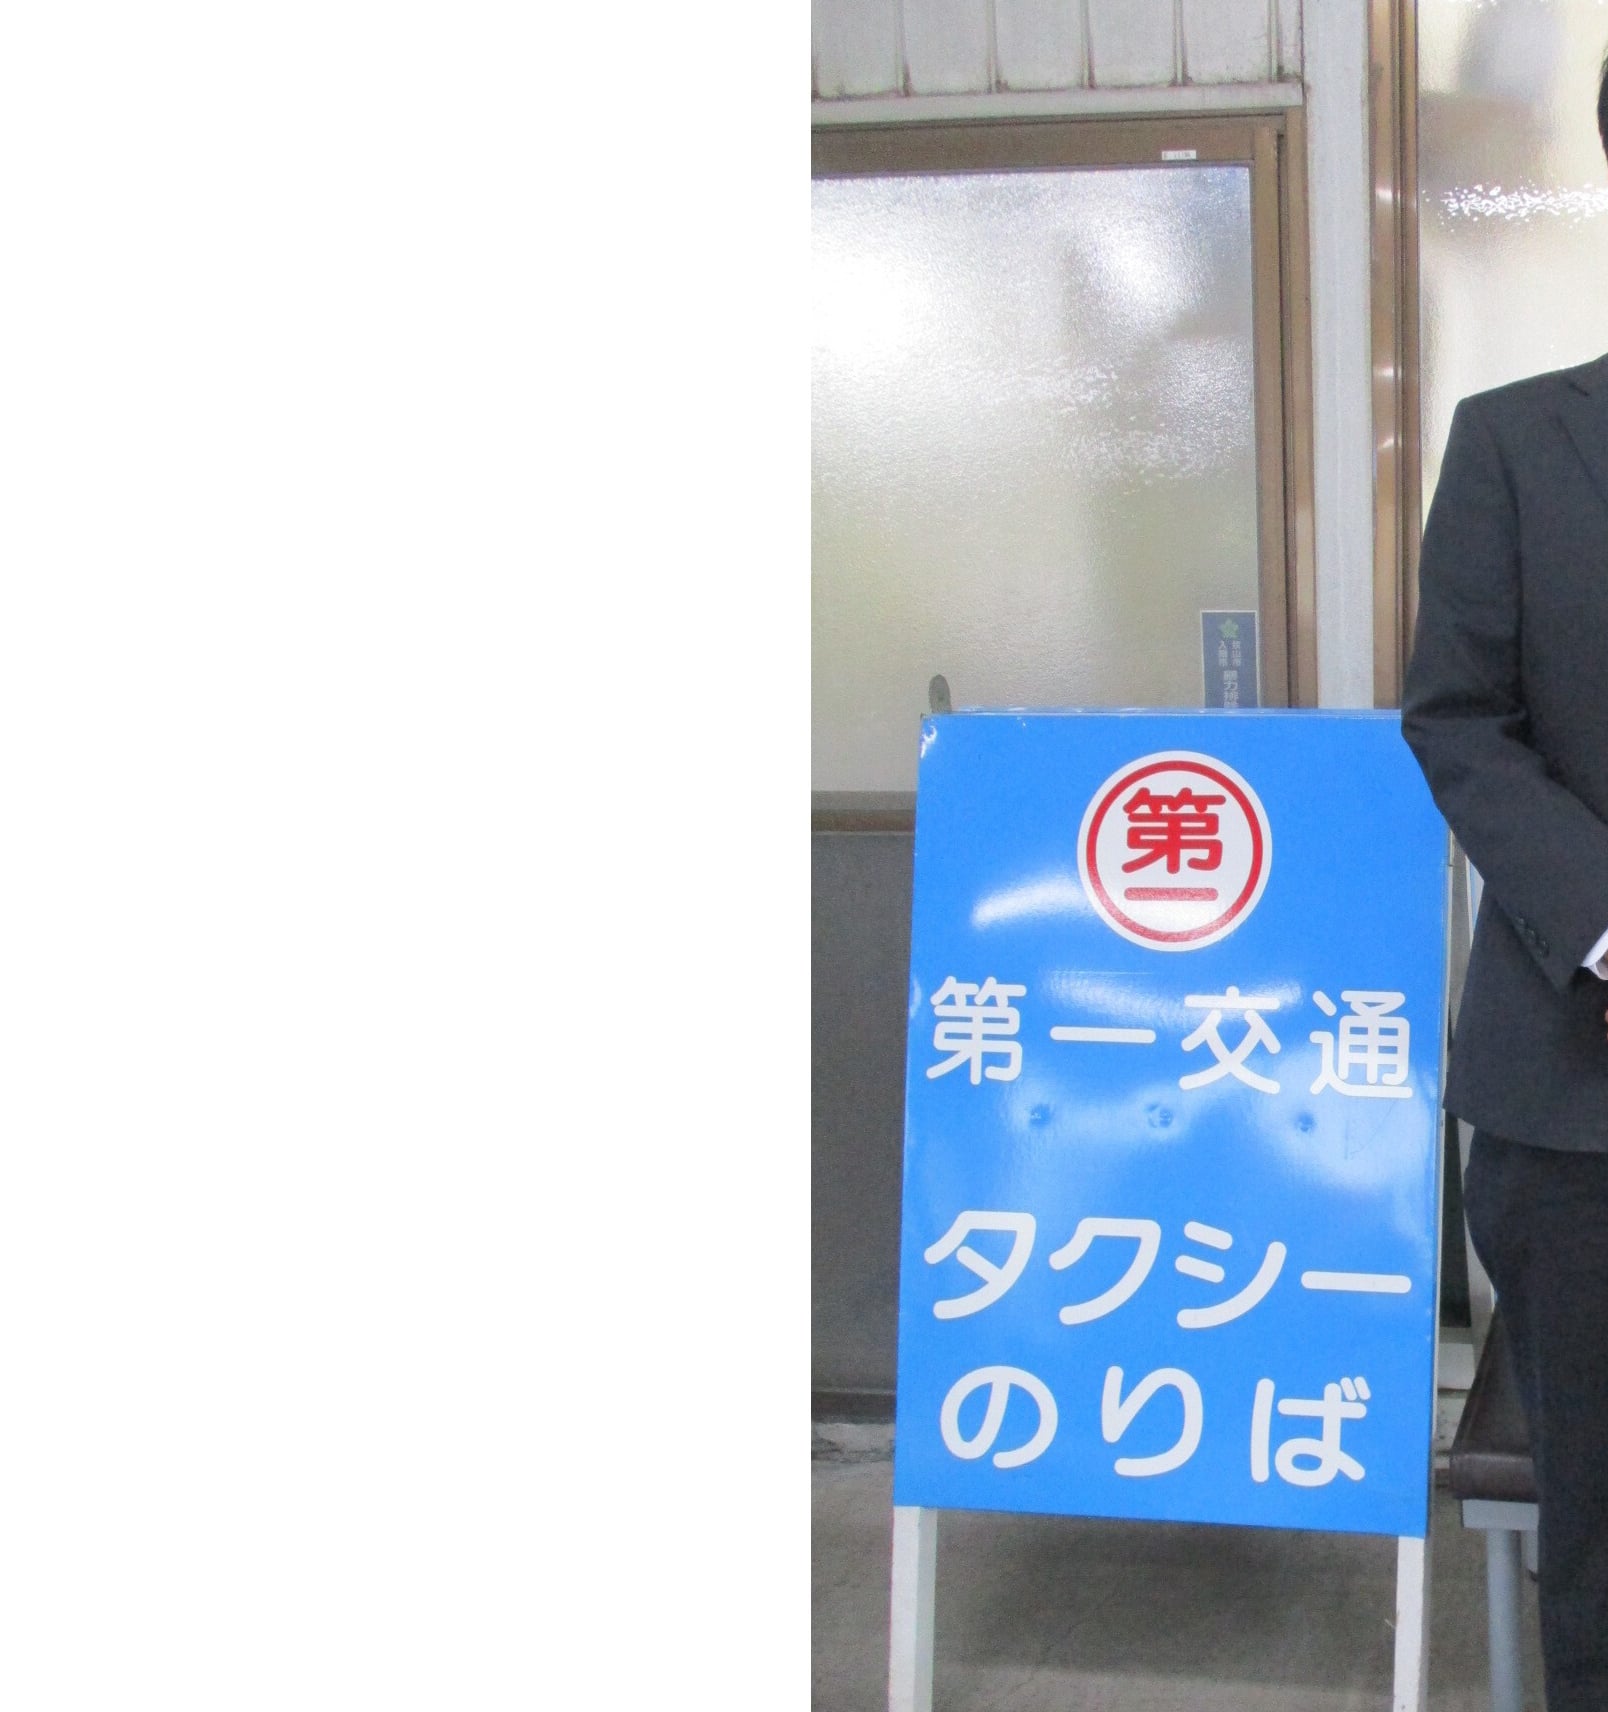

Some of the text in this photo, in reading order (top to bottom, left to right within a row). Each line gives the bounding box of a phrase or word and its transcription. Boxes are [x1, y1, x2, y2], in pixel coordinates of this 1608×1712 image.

[1121, 787, 1227, 902] 第一
[926, 976, 1413, 1099] 第一交通
[924, 1210, 1412, 1329] タクシー
[940, 1365, 1371, 1487] のりば
